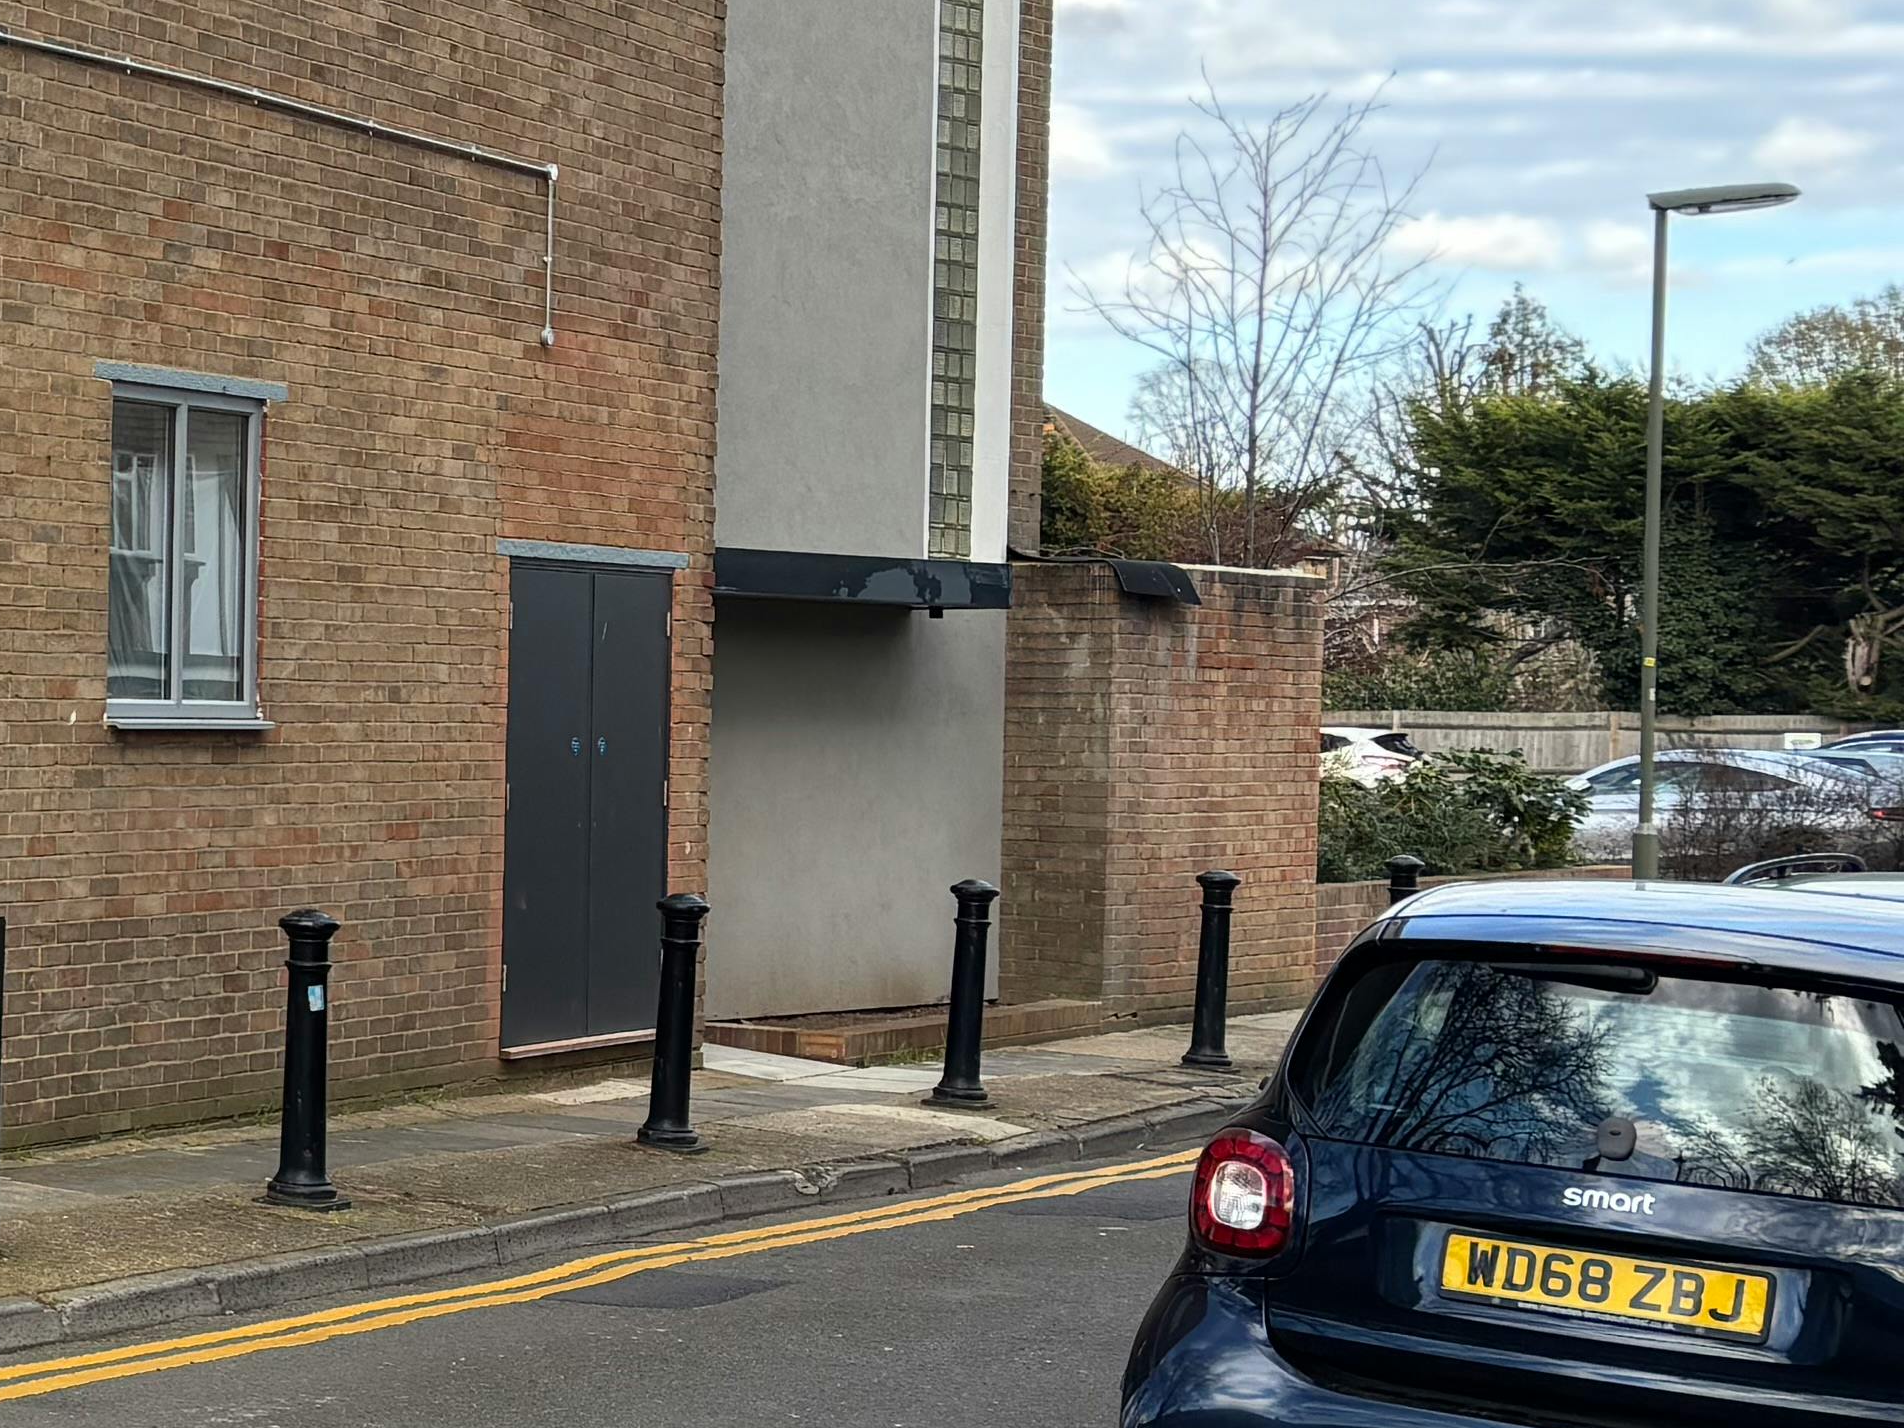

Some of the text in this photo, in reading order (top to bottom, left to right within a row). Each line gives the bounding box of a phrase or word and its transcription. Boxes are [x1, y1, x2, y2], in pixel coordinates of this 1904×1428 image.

[1563, 1184, 1656, 1215] smart
[1466, 1241, 1613, 1305] WD68
[1628, 1263, 1746, 1324] ZBJ
